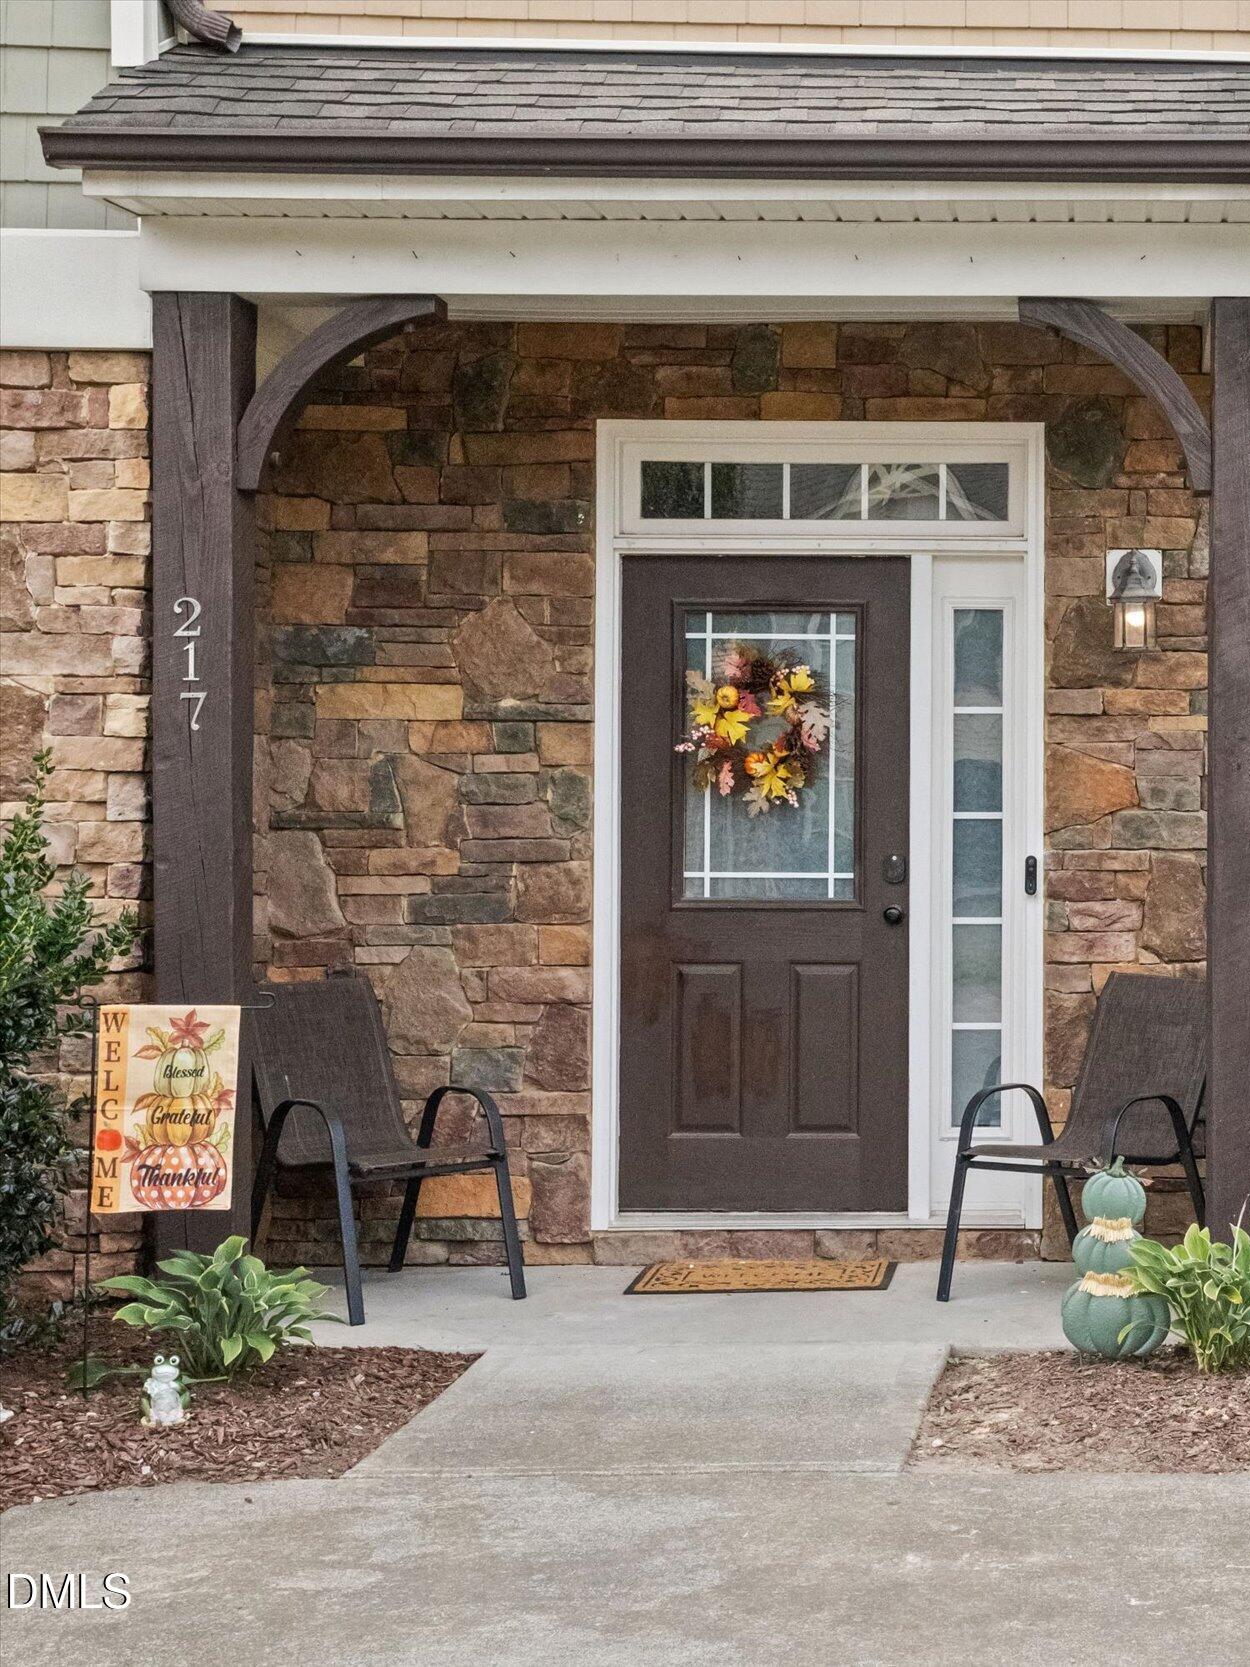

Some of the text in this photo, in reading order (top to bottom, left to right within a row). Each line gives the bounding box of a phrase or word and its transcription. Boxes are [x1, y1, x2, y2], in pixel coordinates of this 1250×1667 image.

[173, 597, 207, 731] 217
[162, 1064, 206, 1080] Blessed
[150, 1104, 213, 1127] Grateful
[137, 1163, 220, 1189] Thankful
